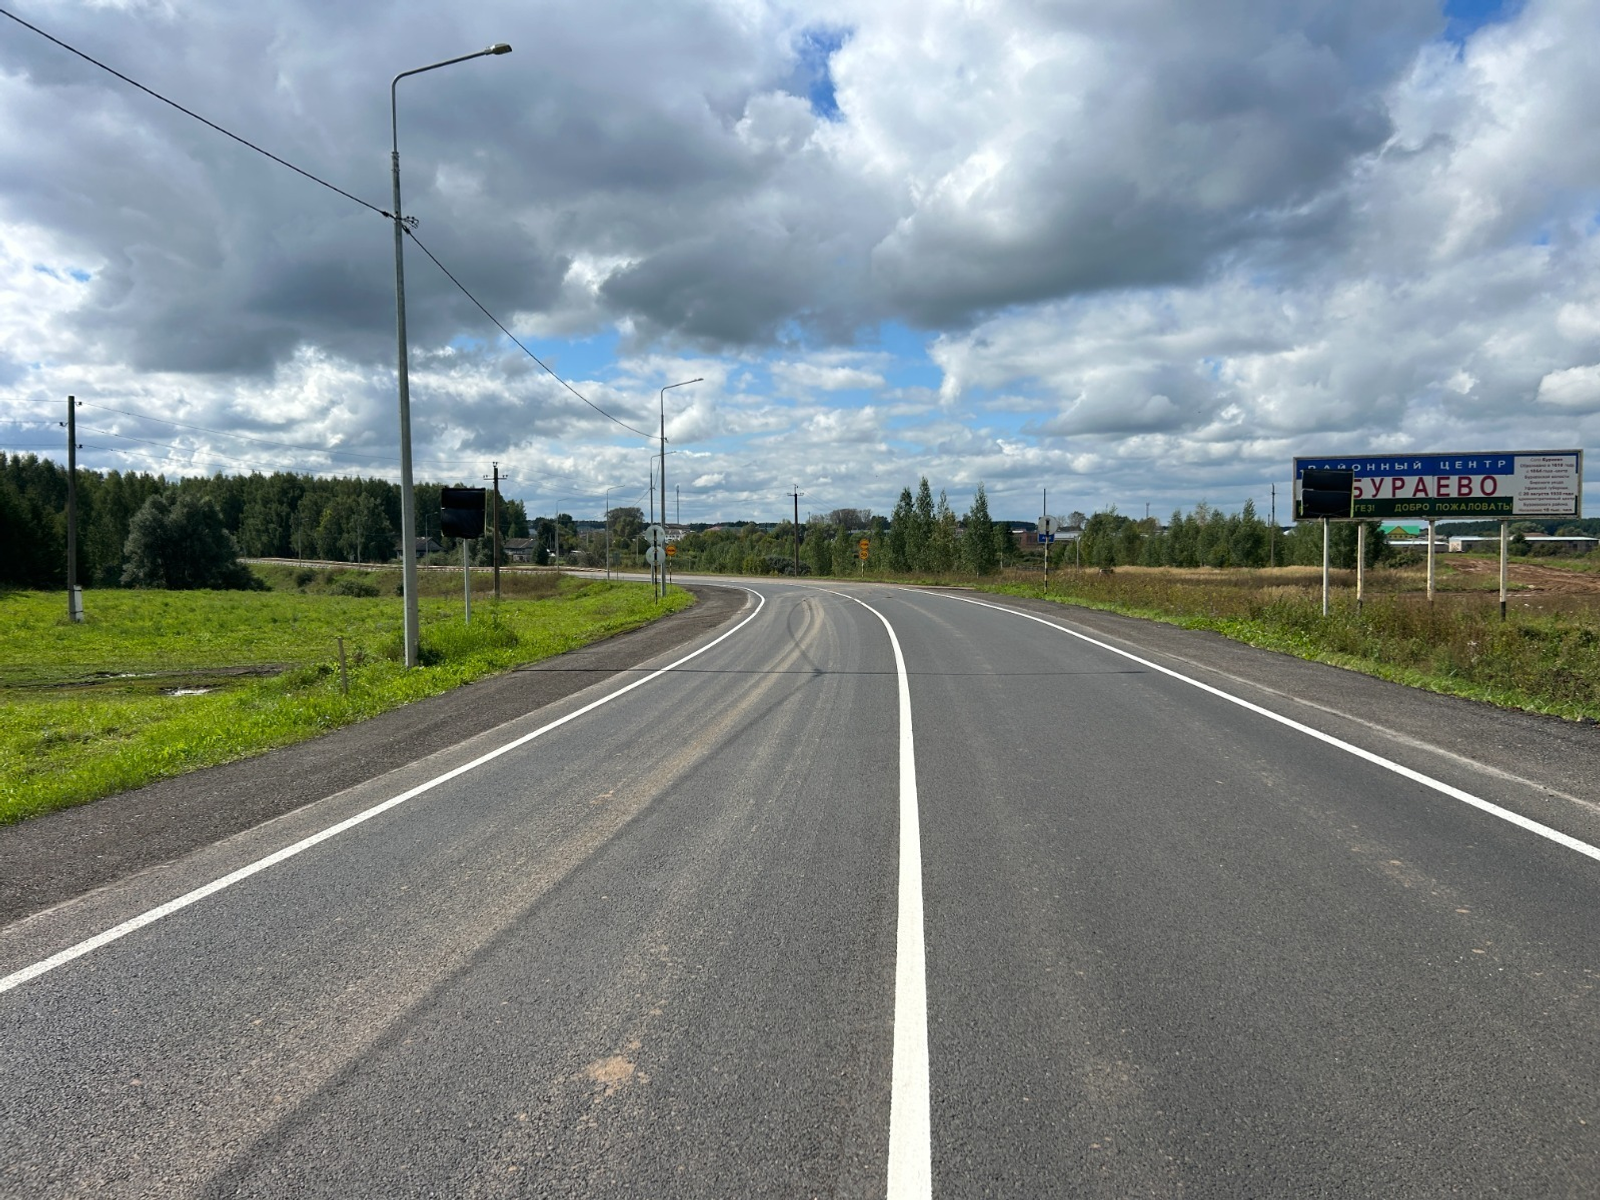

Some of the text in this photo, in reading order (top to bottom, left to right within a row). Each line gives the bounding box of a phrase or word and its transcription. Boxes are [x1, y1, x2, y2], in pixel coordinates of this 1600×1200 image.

[1440, 460, 1506, 471] ЦЕНТР
[1354, 475, 1497, 499] БУРАЕВО
[1394, 503, 1430, 512] ДОБРО
